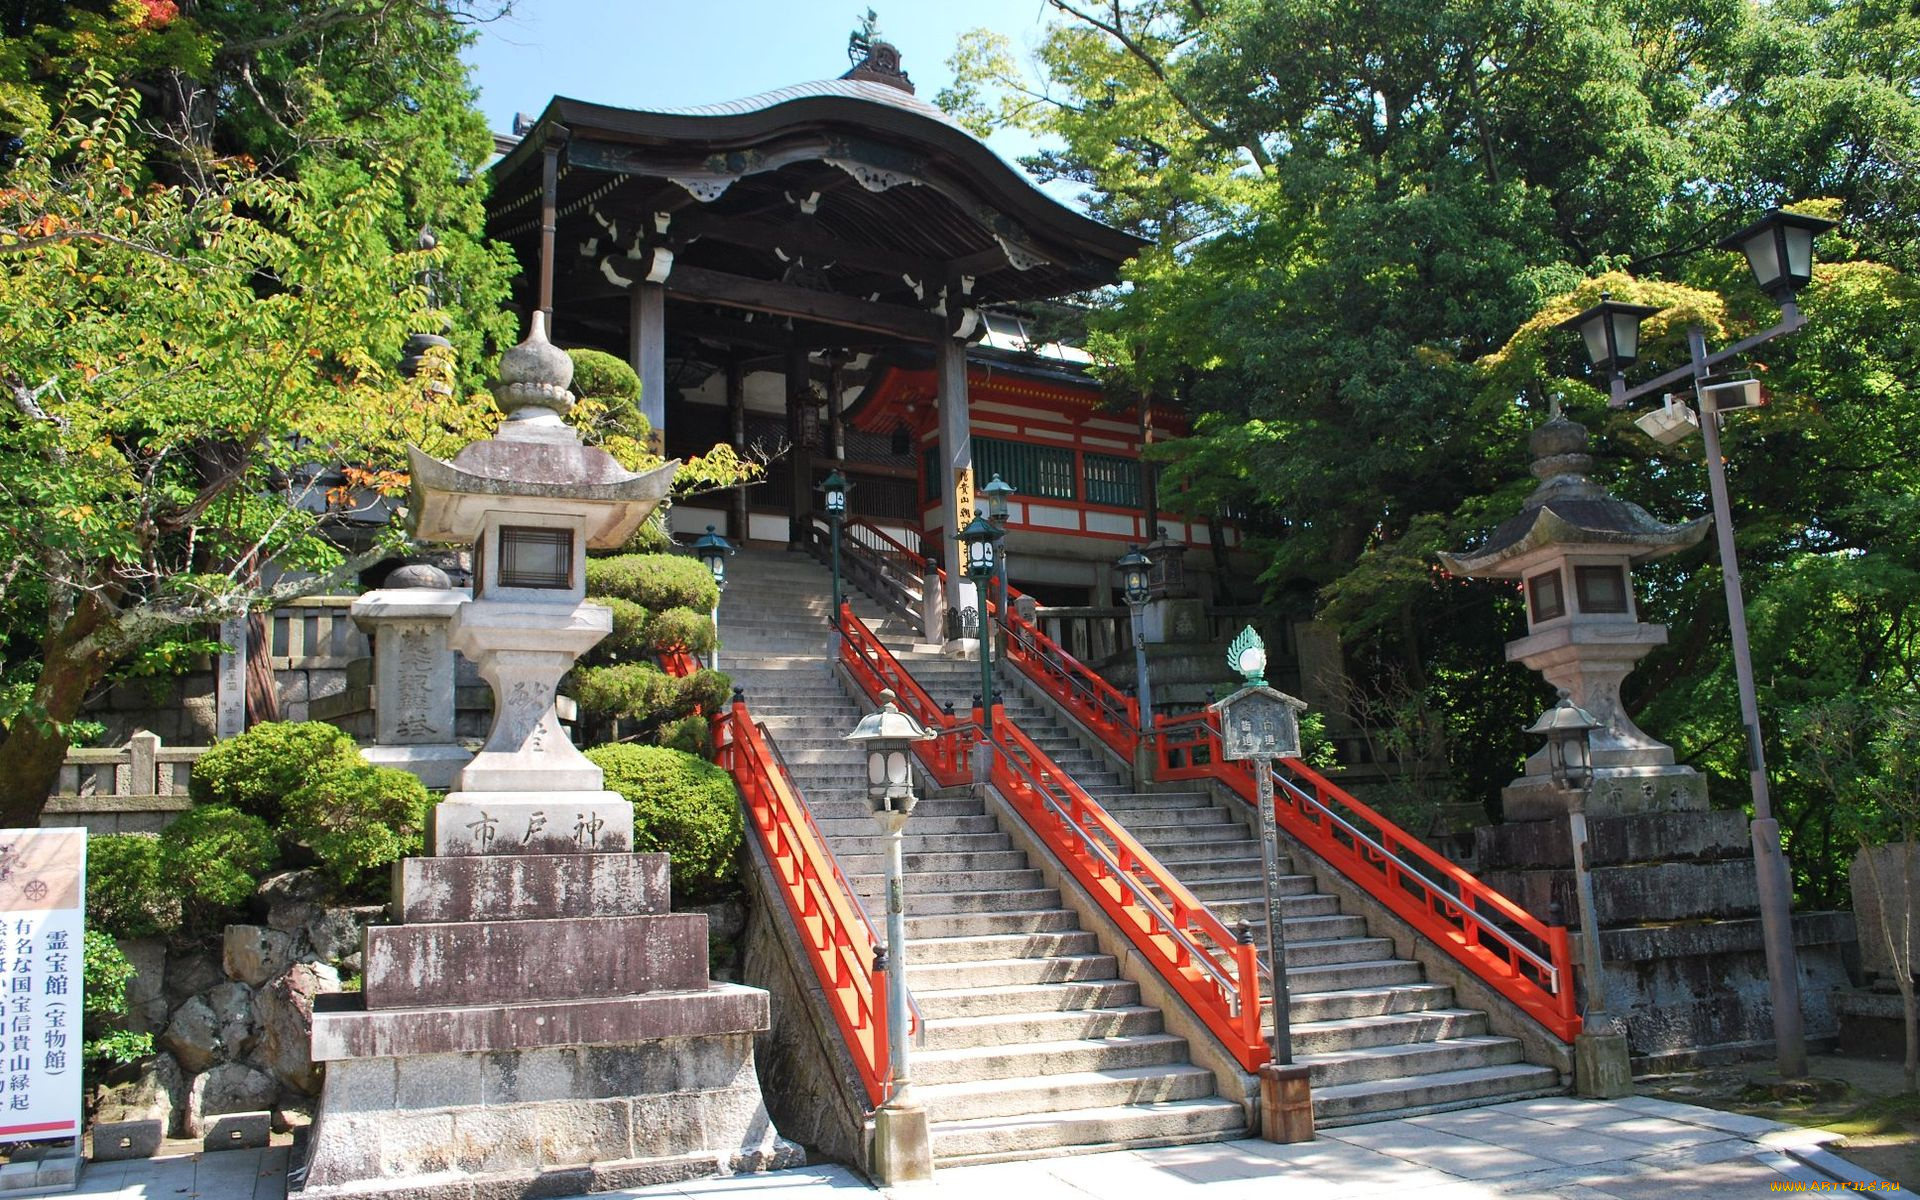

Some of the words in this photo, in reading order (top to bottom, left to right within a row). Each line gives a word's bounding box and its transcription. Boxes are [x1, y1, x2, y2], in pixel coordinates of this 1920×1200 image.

[10, 918, 33, 1111] 有名な国宝信貴山縁起
[45, 930, 69, 1076] 霊宝館（宝物館）
